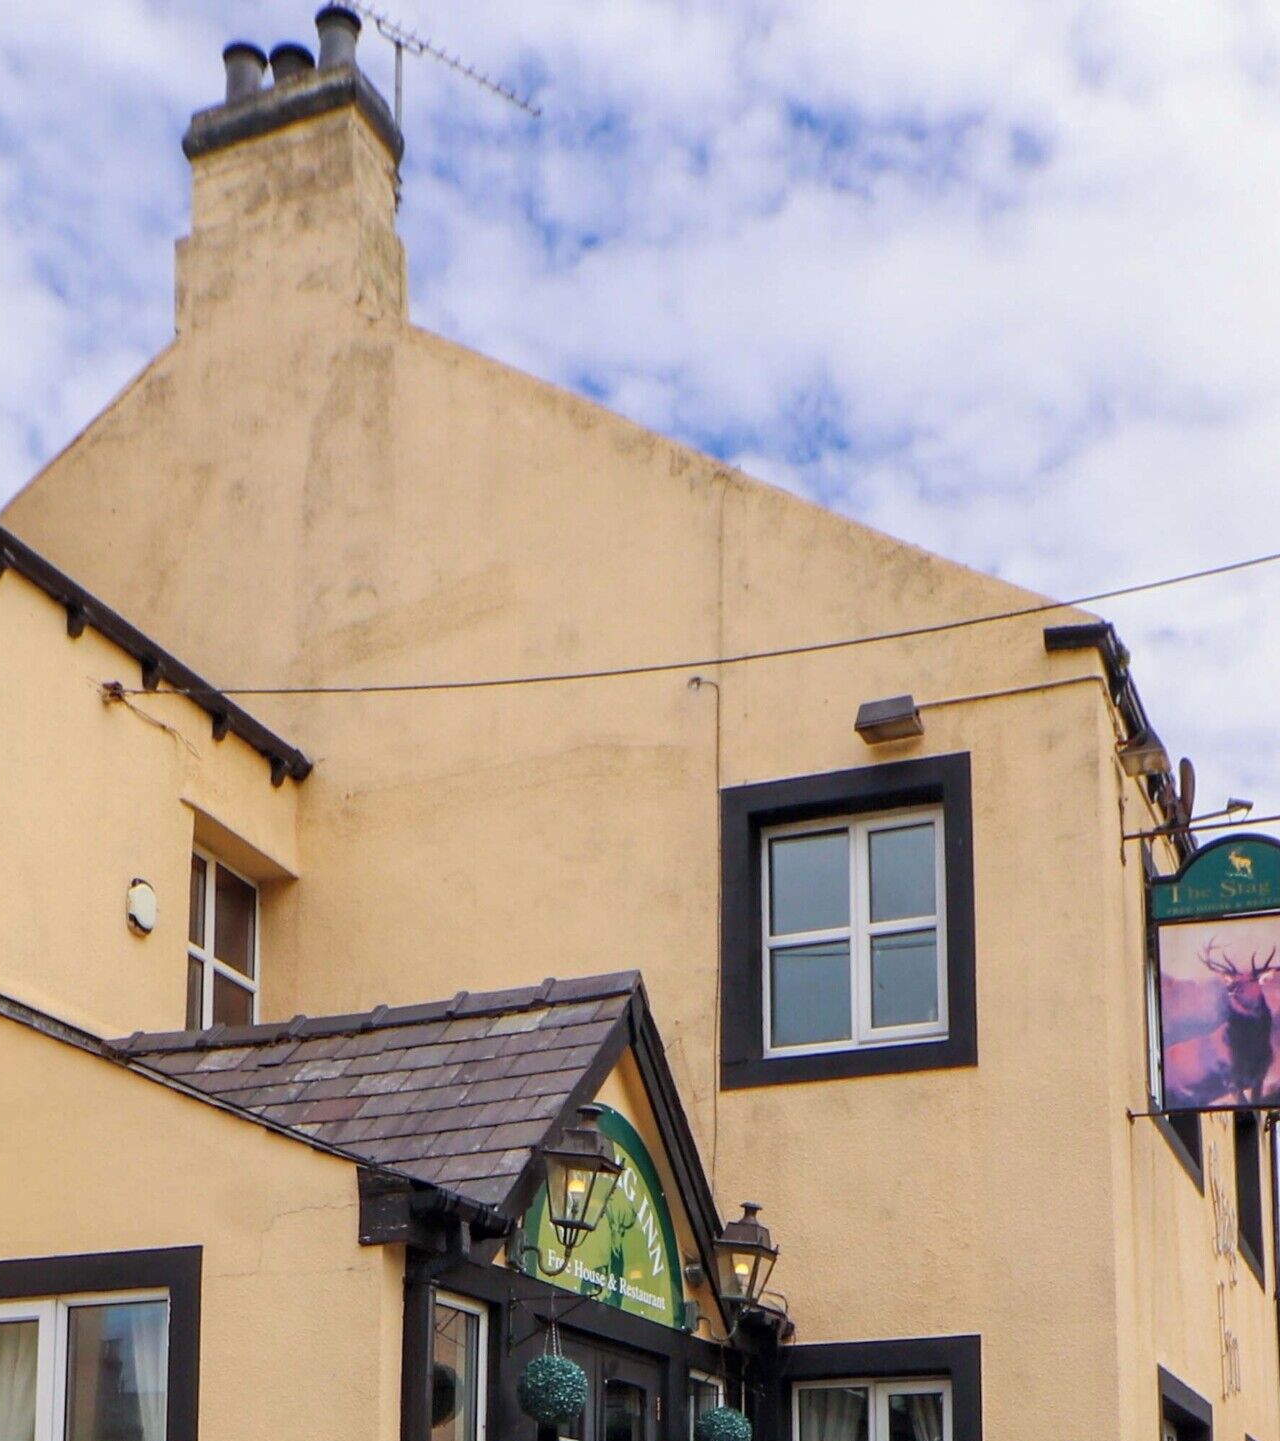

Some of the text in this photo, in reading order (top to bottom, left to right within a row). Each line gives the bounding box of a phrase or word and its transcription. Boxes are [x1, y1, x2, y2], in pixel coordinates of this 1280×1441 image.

[1167, 883, 1212, 904] The
[1220, 880, 1270, 897] Stag
[637, 1193, 664, 1277] INN
[548, 1249, 665, 1310] Free House & Restaurant
